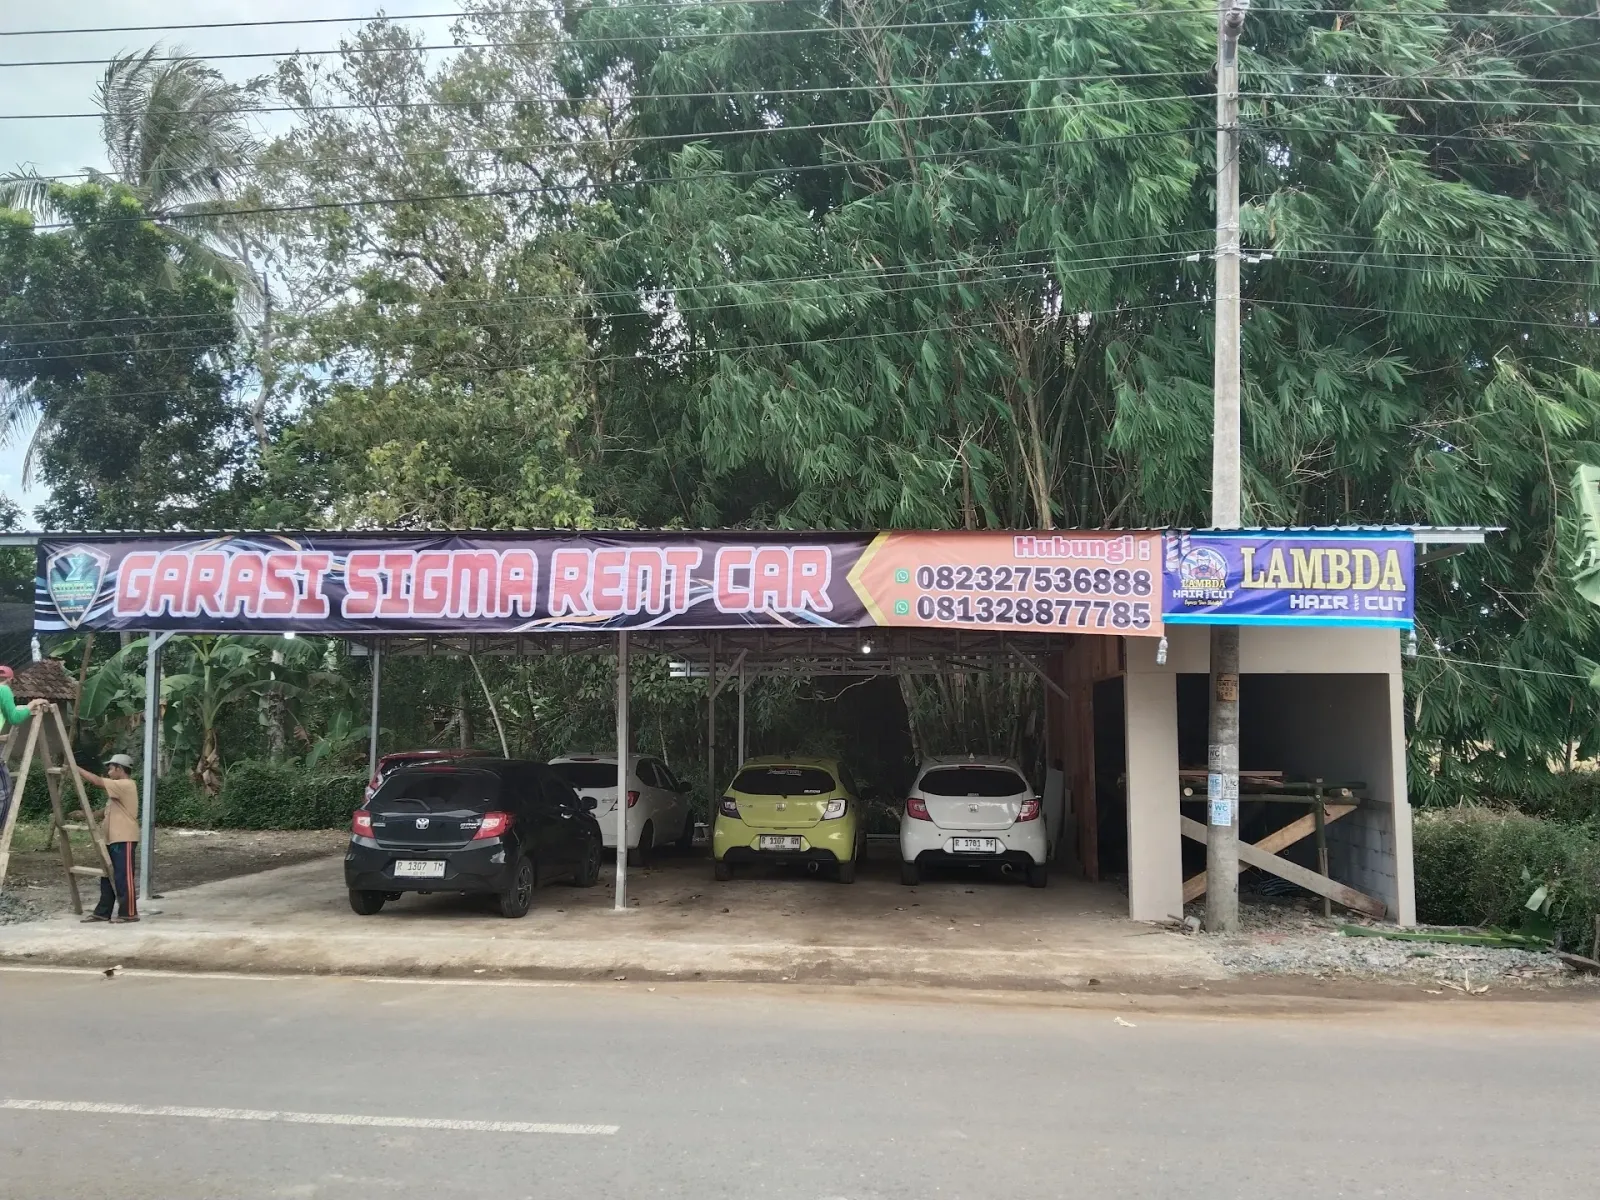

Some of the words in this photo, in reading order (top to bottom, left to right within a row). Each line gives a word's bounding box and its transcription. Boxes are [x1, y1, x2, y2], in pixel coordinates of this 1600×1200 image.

[1013, 535, 1134, 564] Hubungi
[1240, 548, 1406, 591] LAMBDA
[113, 550, 334, 618] GARASI
[341, 549, 538, 619] SIGMA
[548, 547, 702, 618] RENT
[714, 546, 833, 614] CAR
[916, 565, 1152, 597] 082327536888
[1181, 579, 1226, 589] LAMBDA
[1172, 589, 1204, 599] HAIR
[1211, 590, 1234, 599] CUT
[1290, 595, 1350, 610] HAIR
[1364, 596, 1406, 611] CUT
[916, 595, 1152, 630] 081328877785
[1214, 804, 1228, 812] WC
[396, 861, 403, 870] R
[407, 861, 427, 871] 1307
[434, 862, 444, 871] TM
